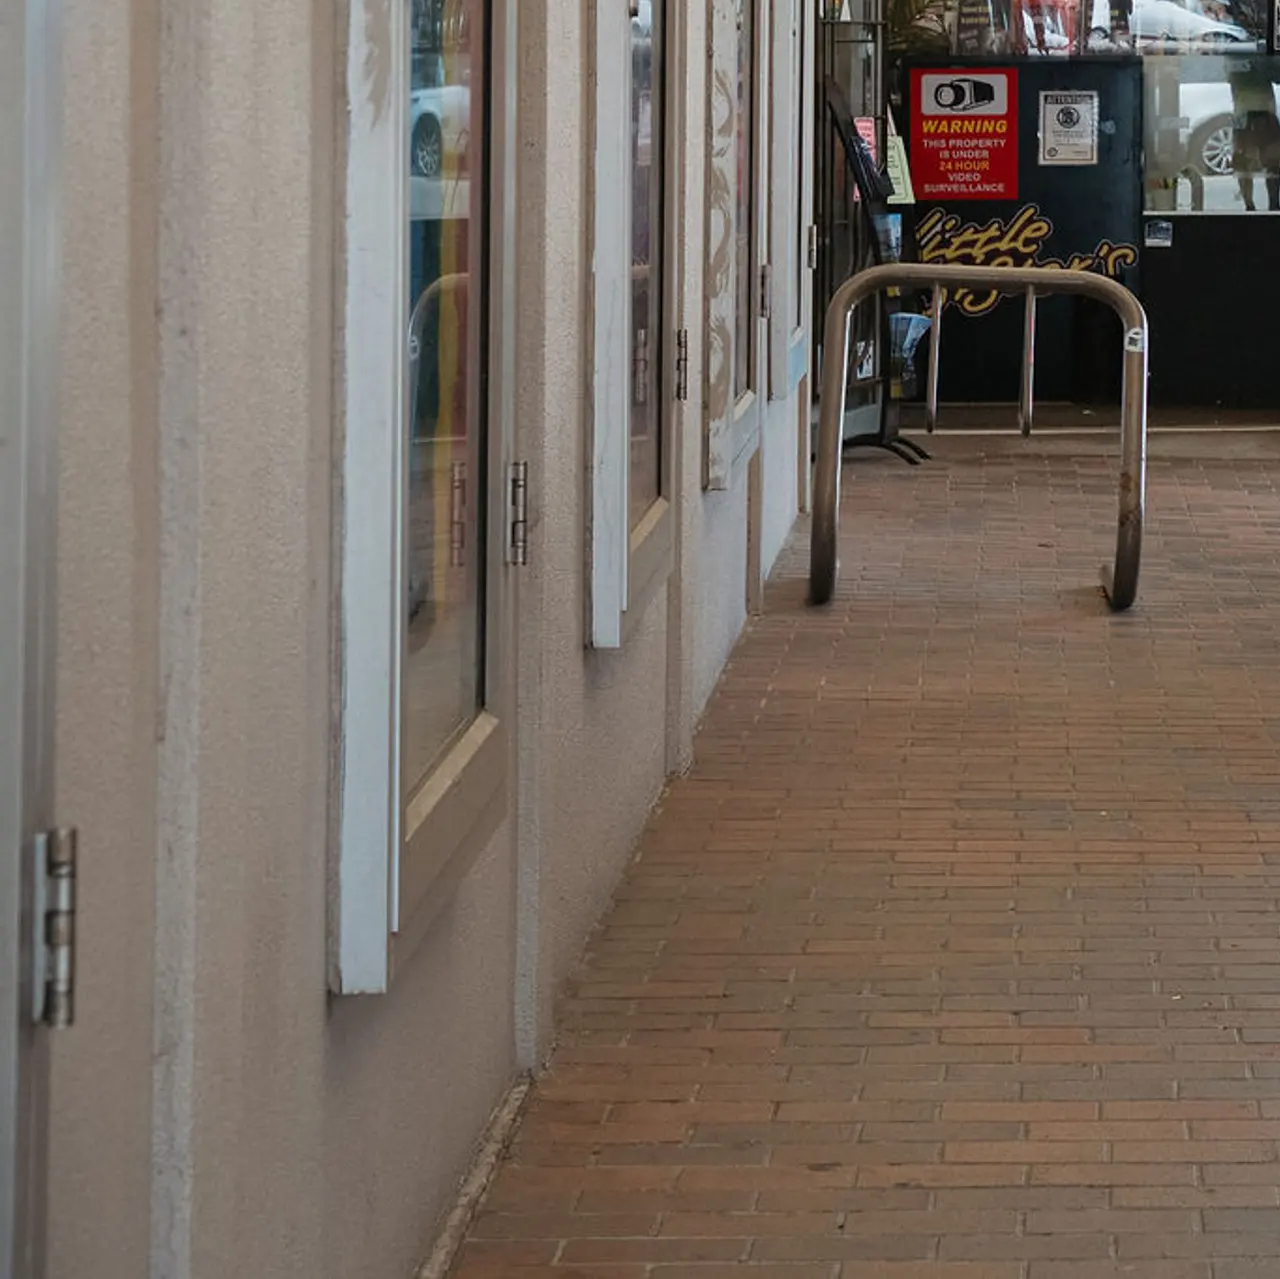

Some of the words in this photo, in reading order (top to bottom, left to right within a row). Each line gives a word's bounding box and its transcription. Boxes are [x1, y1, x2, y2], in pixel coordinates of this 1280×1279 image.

[922, 119, 1008, 133] WARNING
[923, 139, 946, 148] THIS
[949, 138, 1006, 149] PROPERTY
[940, 150, 950, 159] IS
[952, 150, 989, 159] UNDER
[939, 161, 952, 171] 24
[955, 161, 990, 171] HOUR
[947, 173, 981, 182] VIDEO
[923, 184, 1005, 193] SURVEILLANCE
